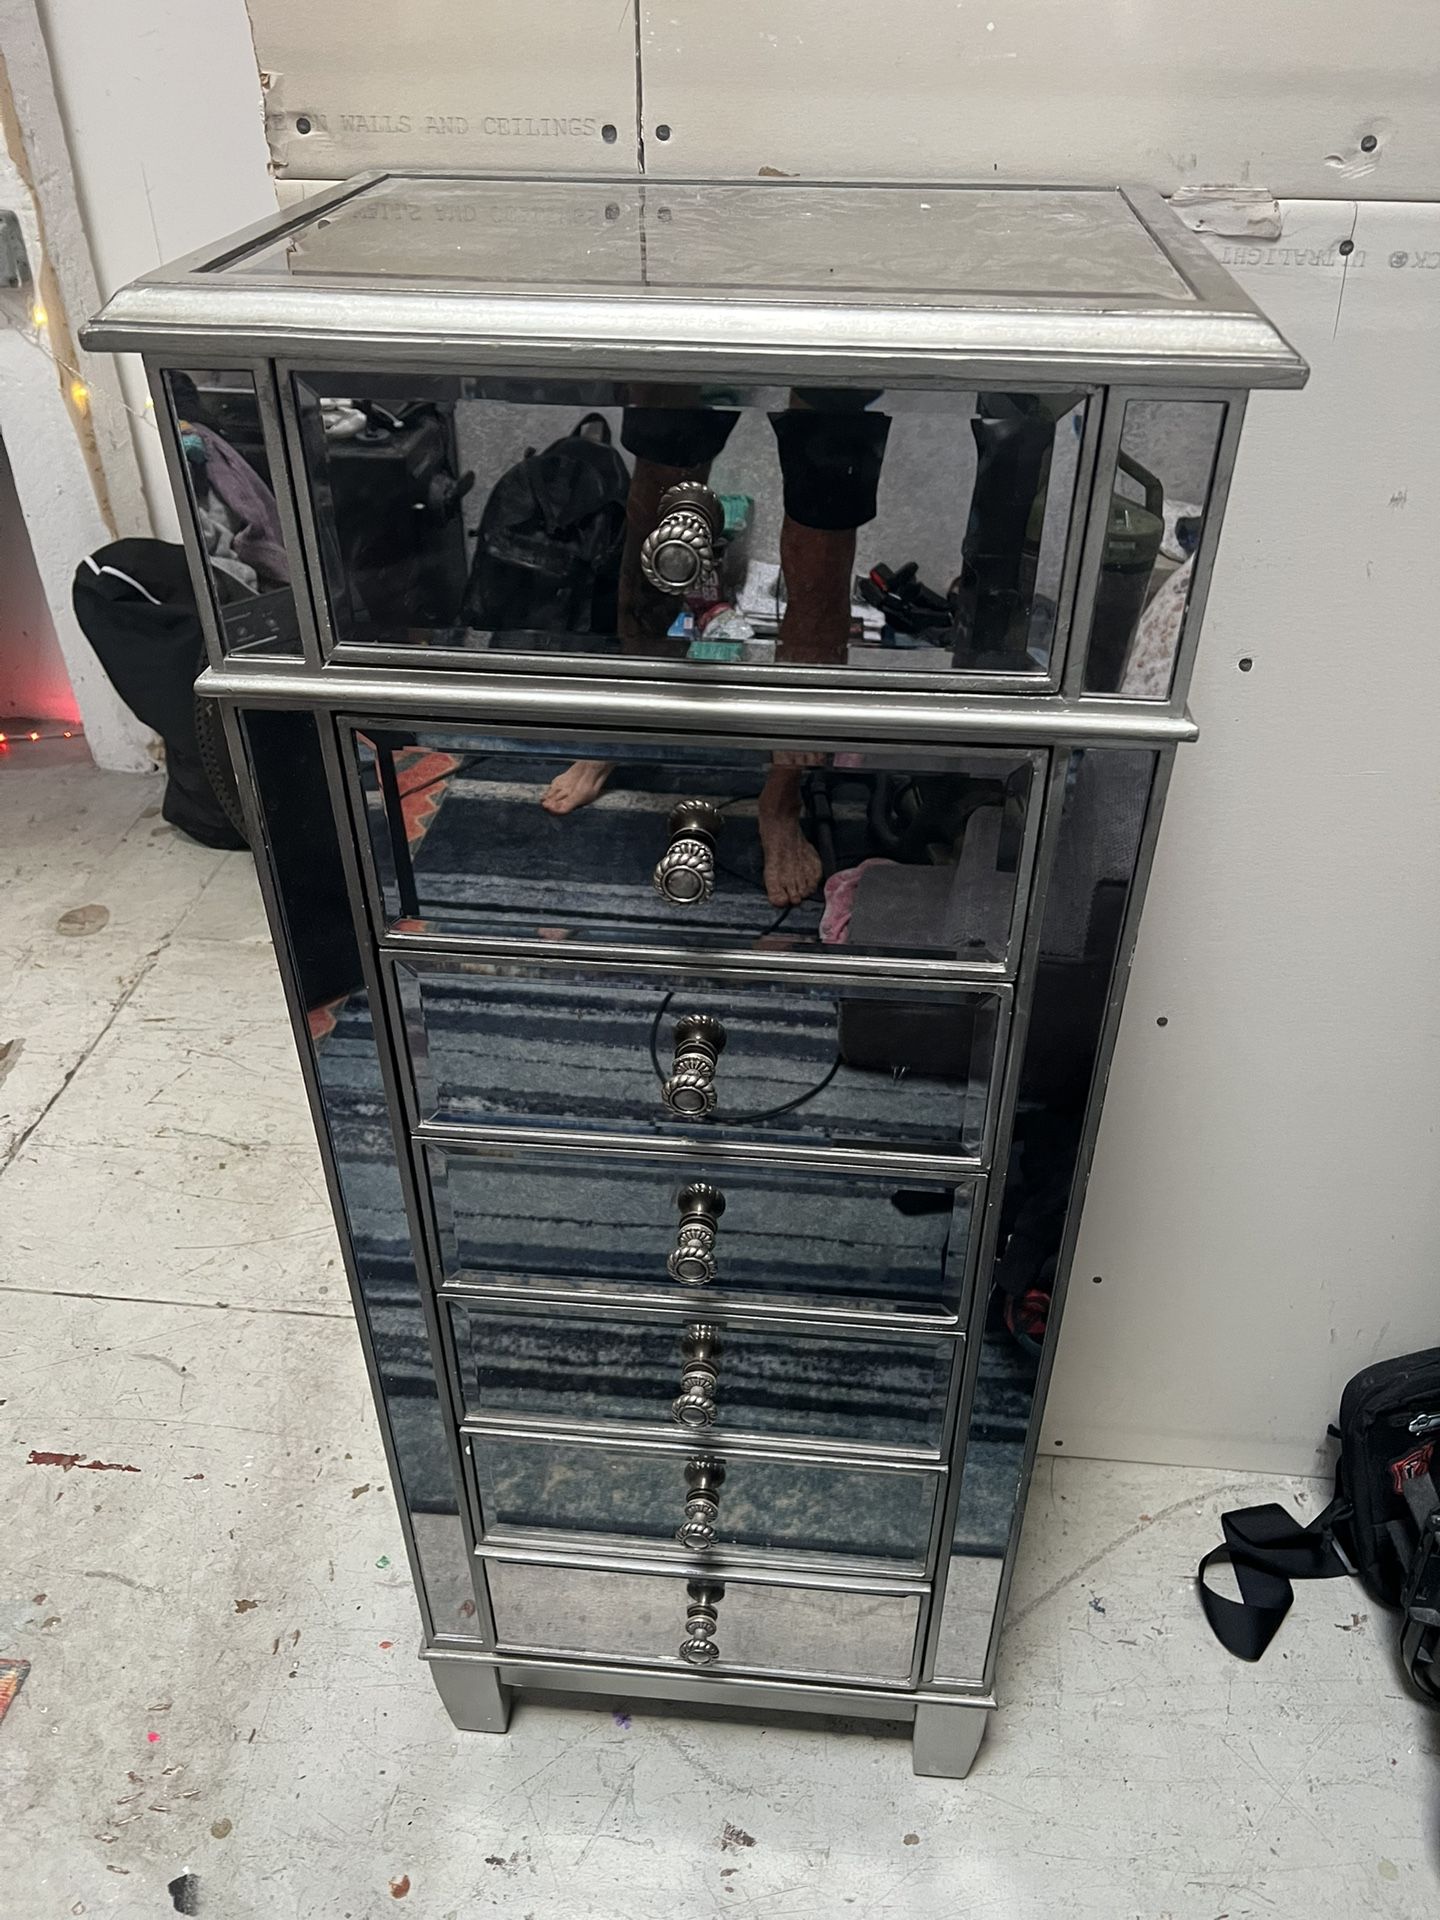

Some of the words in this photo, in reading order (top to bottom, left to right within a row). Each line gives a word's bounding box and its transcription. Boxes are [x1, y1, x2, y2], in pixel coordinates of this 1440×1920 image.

[341, 114, 412, 133] WALLS
[425, 116, 469, 135] AND
[484, 116, 596, 136] CEILINGS
